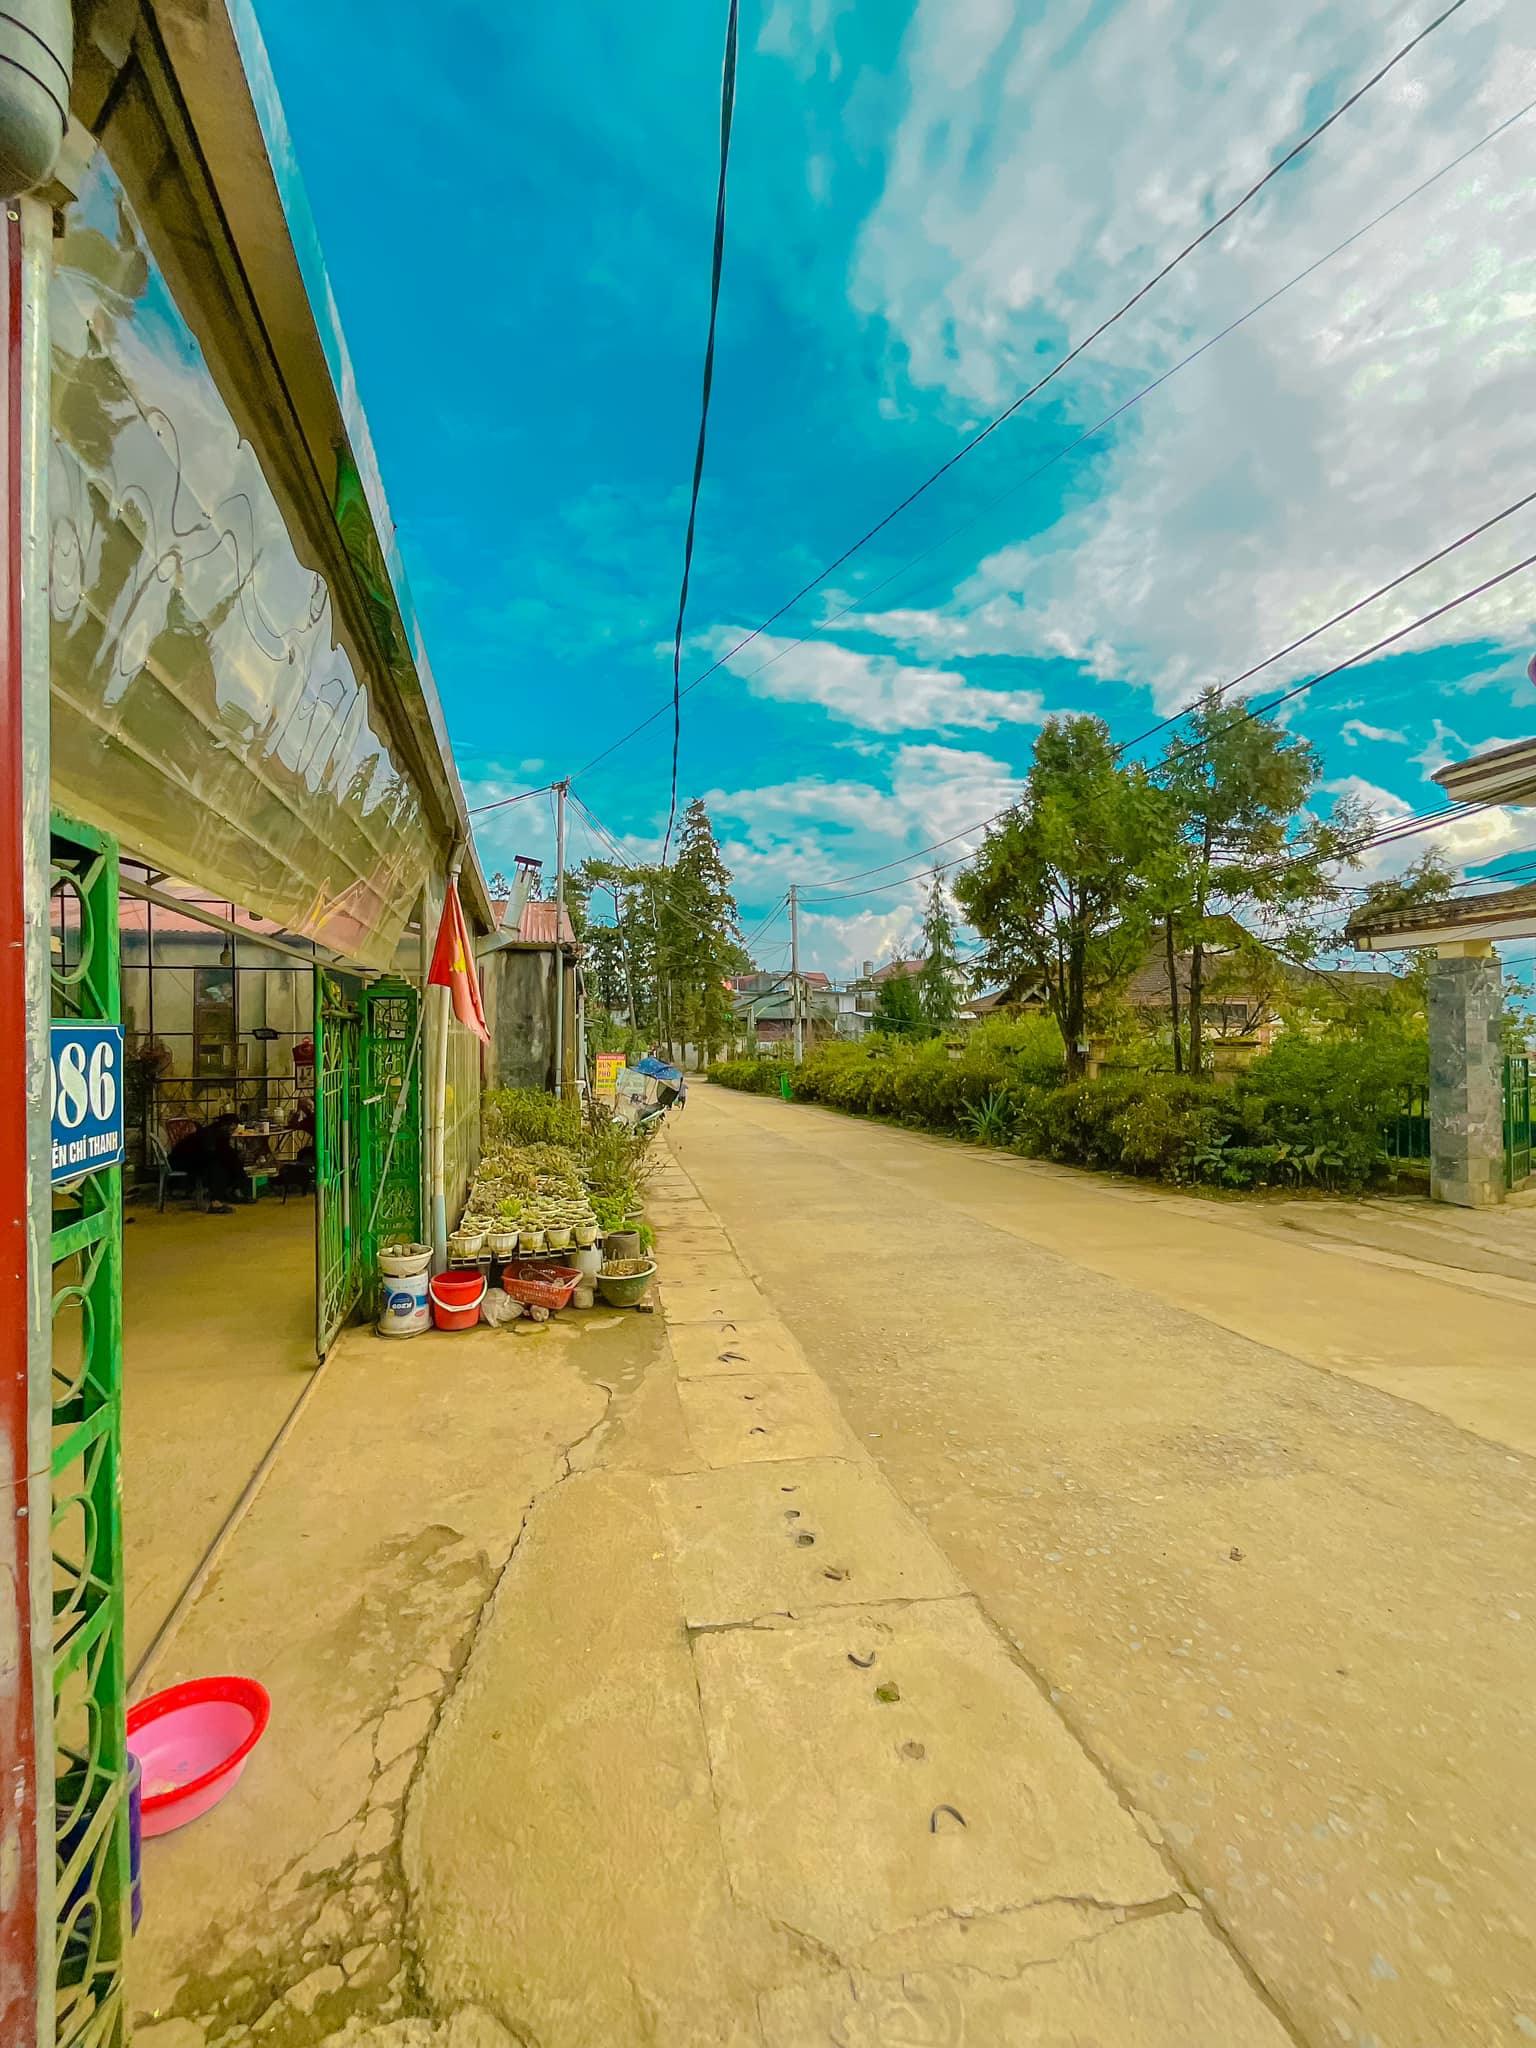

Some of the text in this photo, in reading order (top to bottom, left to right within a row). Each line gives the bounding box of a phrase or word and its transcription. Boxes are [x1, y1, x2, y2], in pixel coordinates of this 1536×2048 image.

[50, 1042, 115, 1128] 86
[69, 1134, 87, 1164] CHÍ
[88, 1131, 118, 1157] THANH
